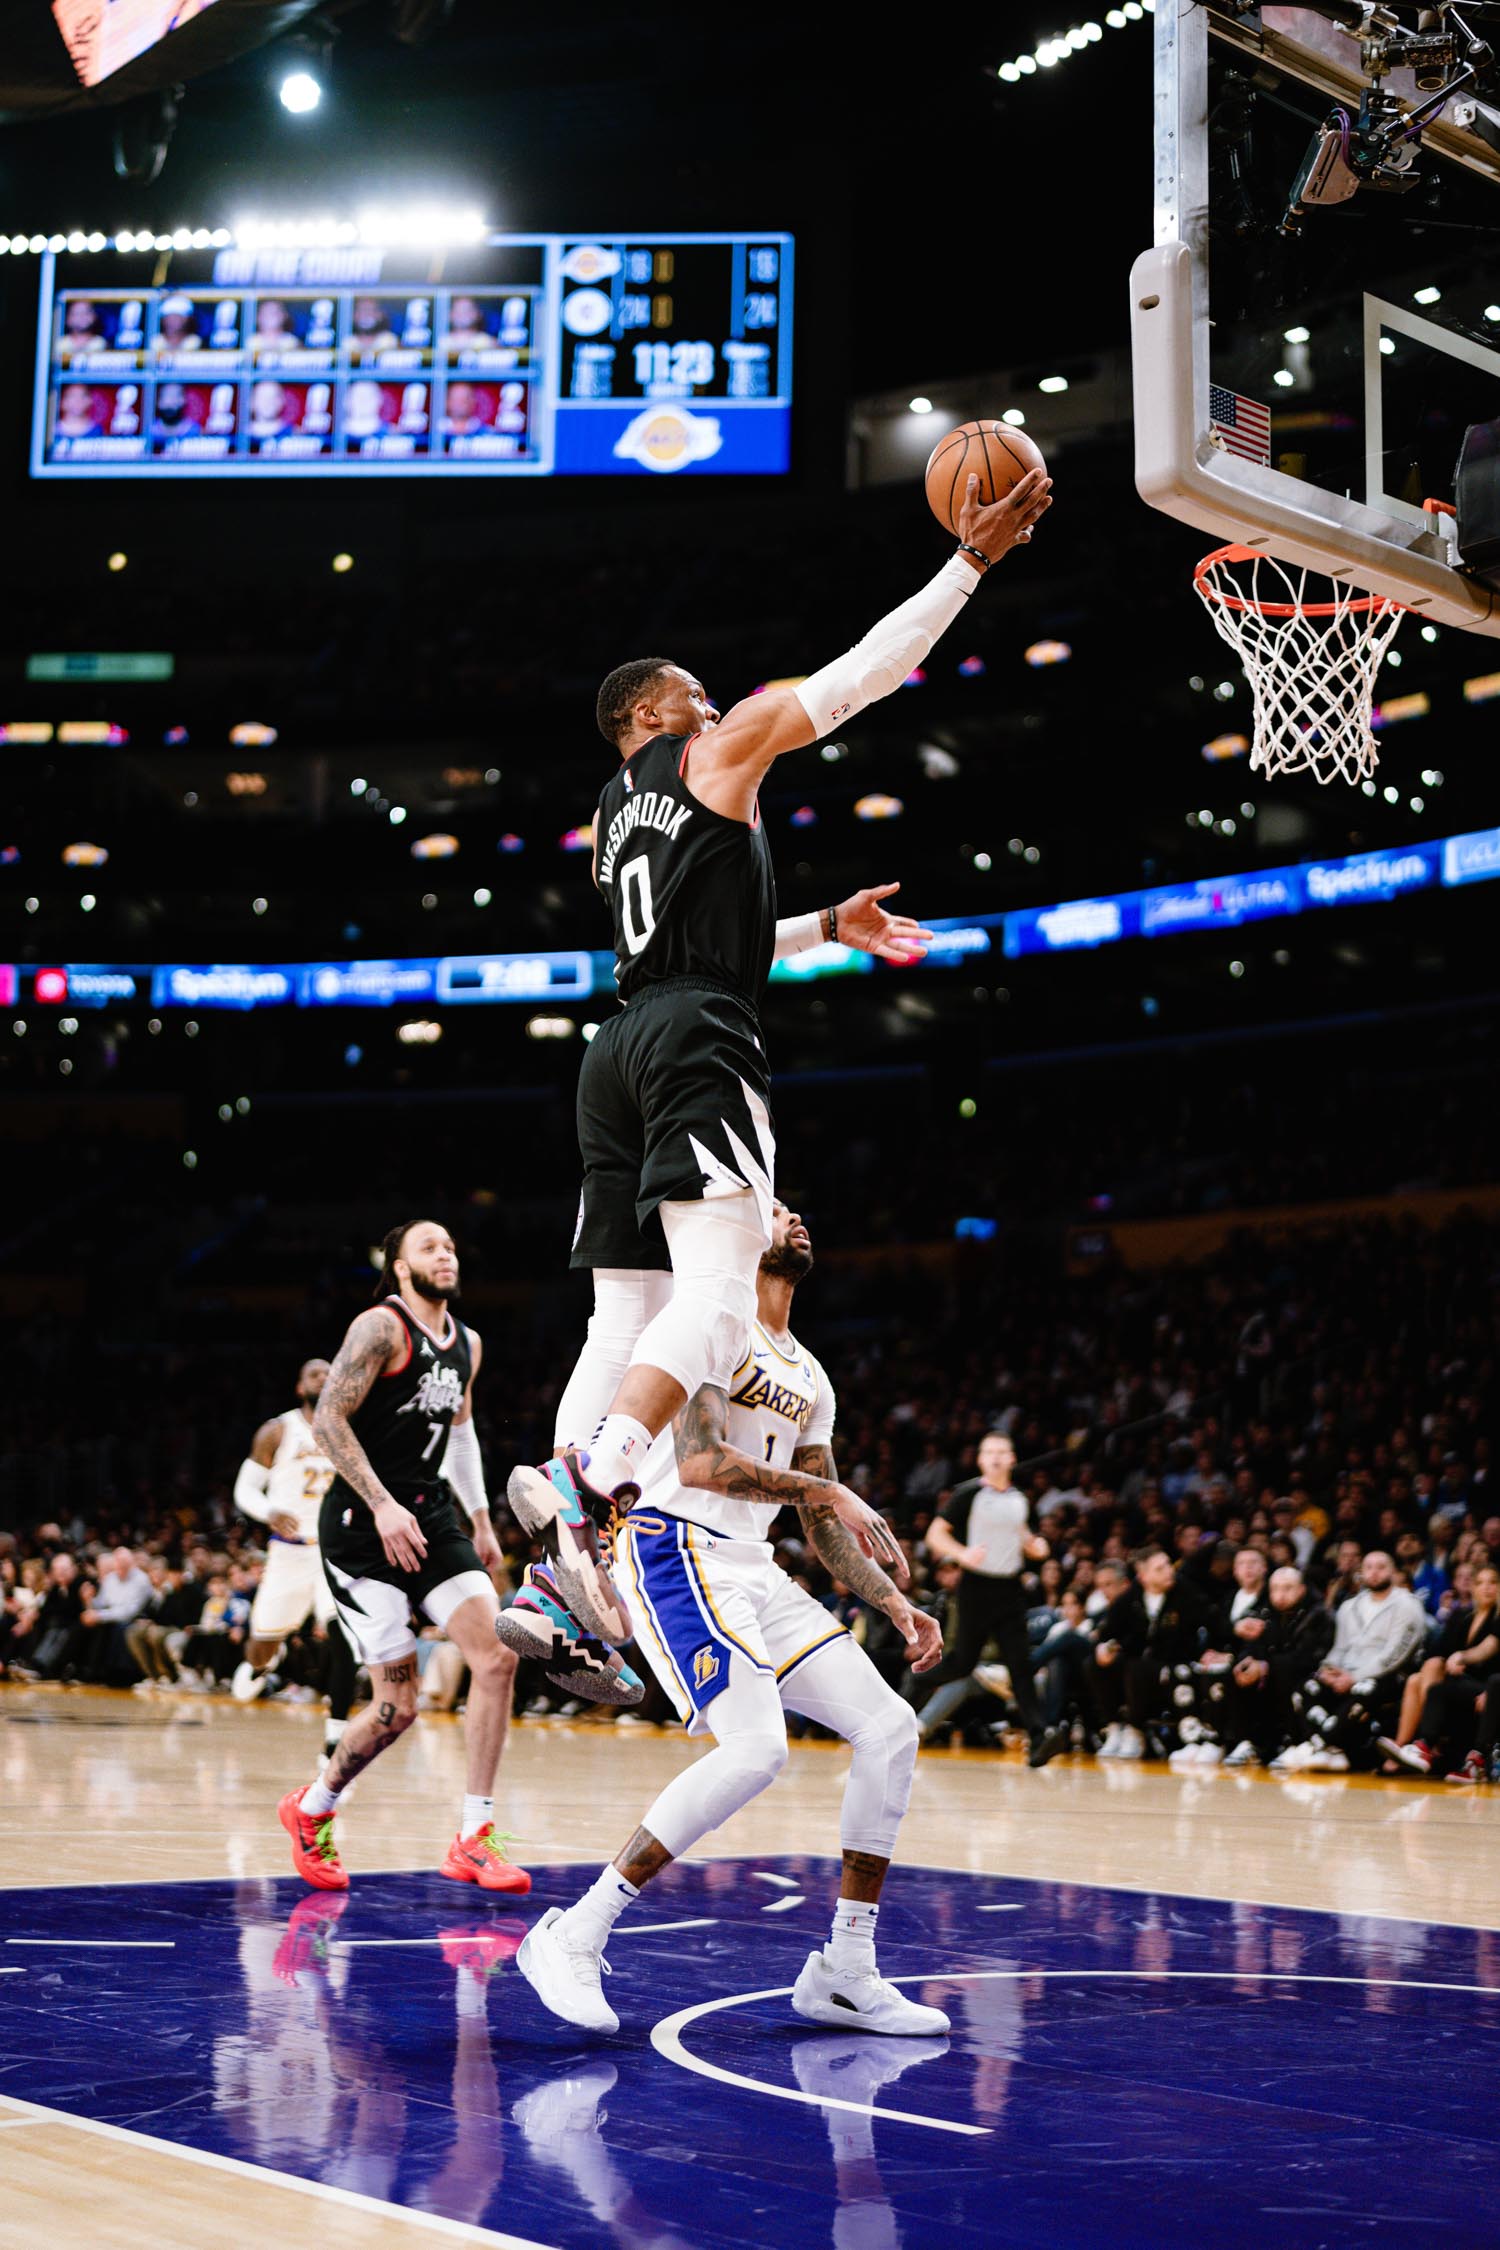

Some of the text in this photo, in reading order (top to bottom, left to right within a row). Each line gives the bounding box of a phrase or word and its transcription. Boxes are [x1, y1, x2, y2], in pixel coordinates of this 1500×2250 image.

[599, 792, 693, 884] WESTBROOK
[1308, 855, 1426, 900] Spectrum
[620, 854, 656, 956] 0
[421, 1422, 444, 1460] 7
[764, 1432, 778, 1463] 1
[384, 1664, 410, 1683] JUST
